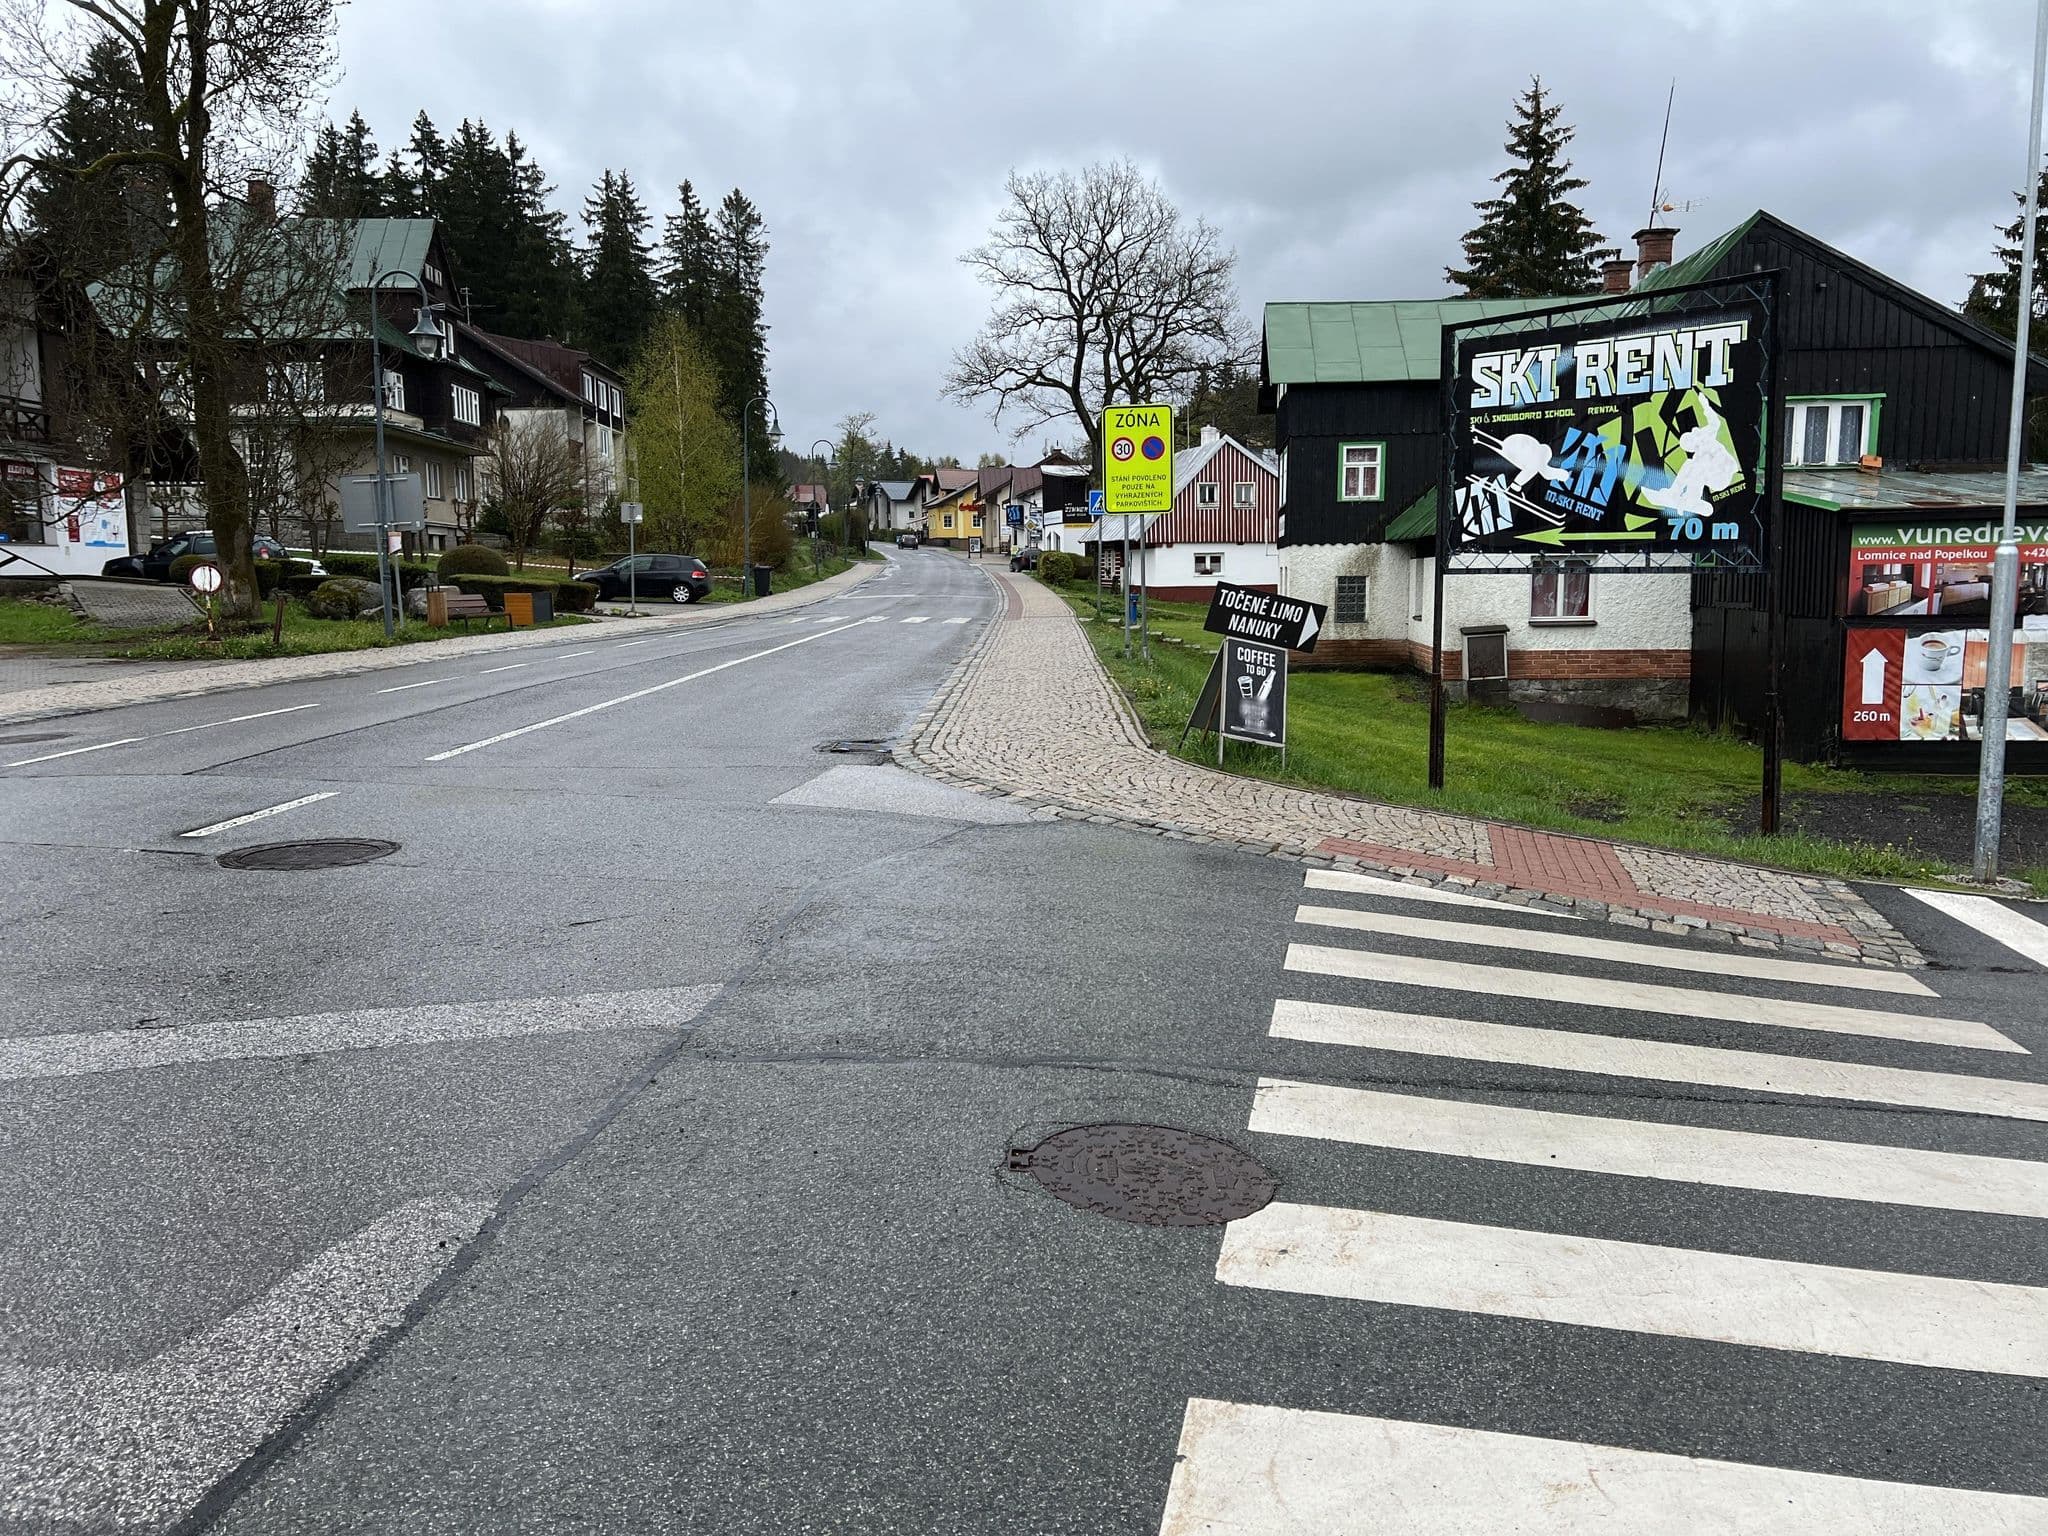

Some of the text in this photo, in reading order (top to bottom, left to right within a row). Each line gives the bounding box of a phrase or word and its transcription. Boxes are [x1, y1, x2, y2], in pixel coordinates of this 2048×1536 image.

[1470, 321, 1747, 409] SKI RENT
[1491, 410, 1542, 423] SNOWBOARD
[1544, 408, 1576, 419] SCHOOL
[1587, 404, 1620, 415] RENTAL
[1115, 409, 1160, 428] ZÓNA
[1116, 443, 1131, 455] 30
[1131, 473, 1167, 482] POVOLENO
[1122, 483, 1143, 491] POUZE
[1574, 501, 1605, 522] RENT
[1667, 518, 1739, 541] 70 m
[1857, 548, 1988, 562] Lomnice nad Popelkou
[1219, 589, 1304, 623] TOČENÉ LIMO
[1228, 613, 1283, 640] NANUKY
[1236, 646, 1276, 668] COFFEE
[1245, 663, 1267, 677] TO GO
[1853, 710, 1891, 722] 260 m
